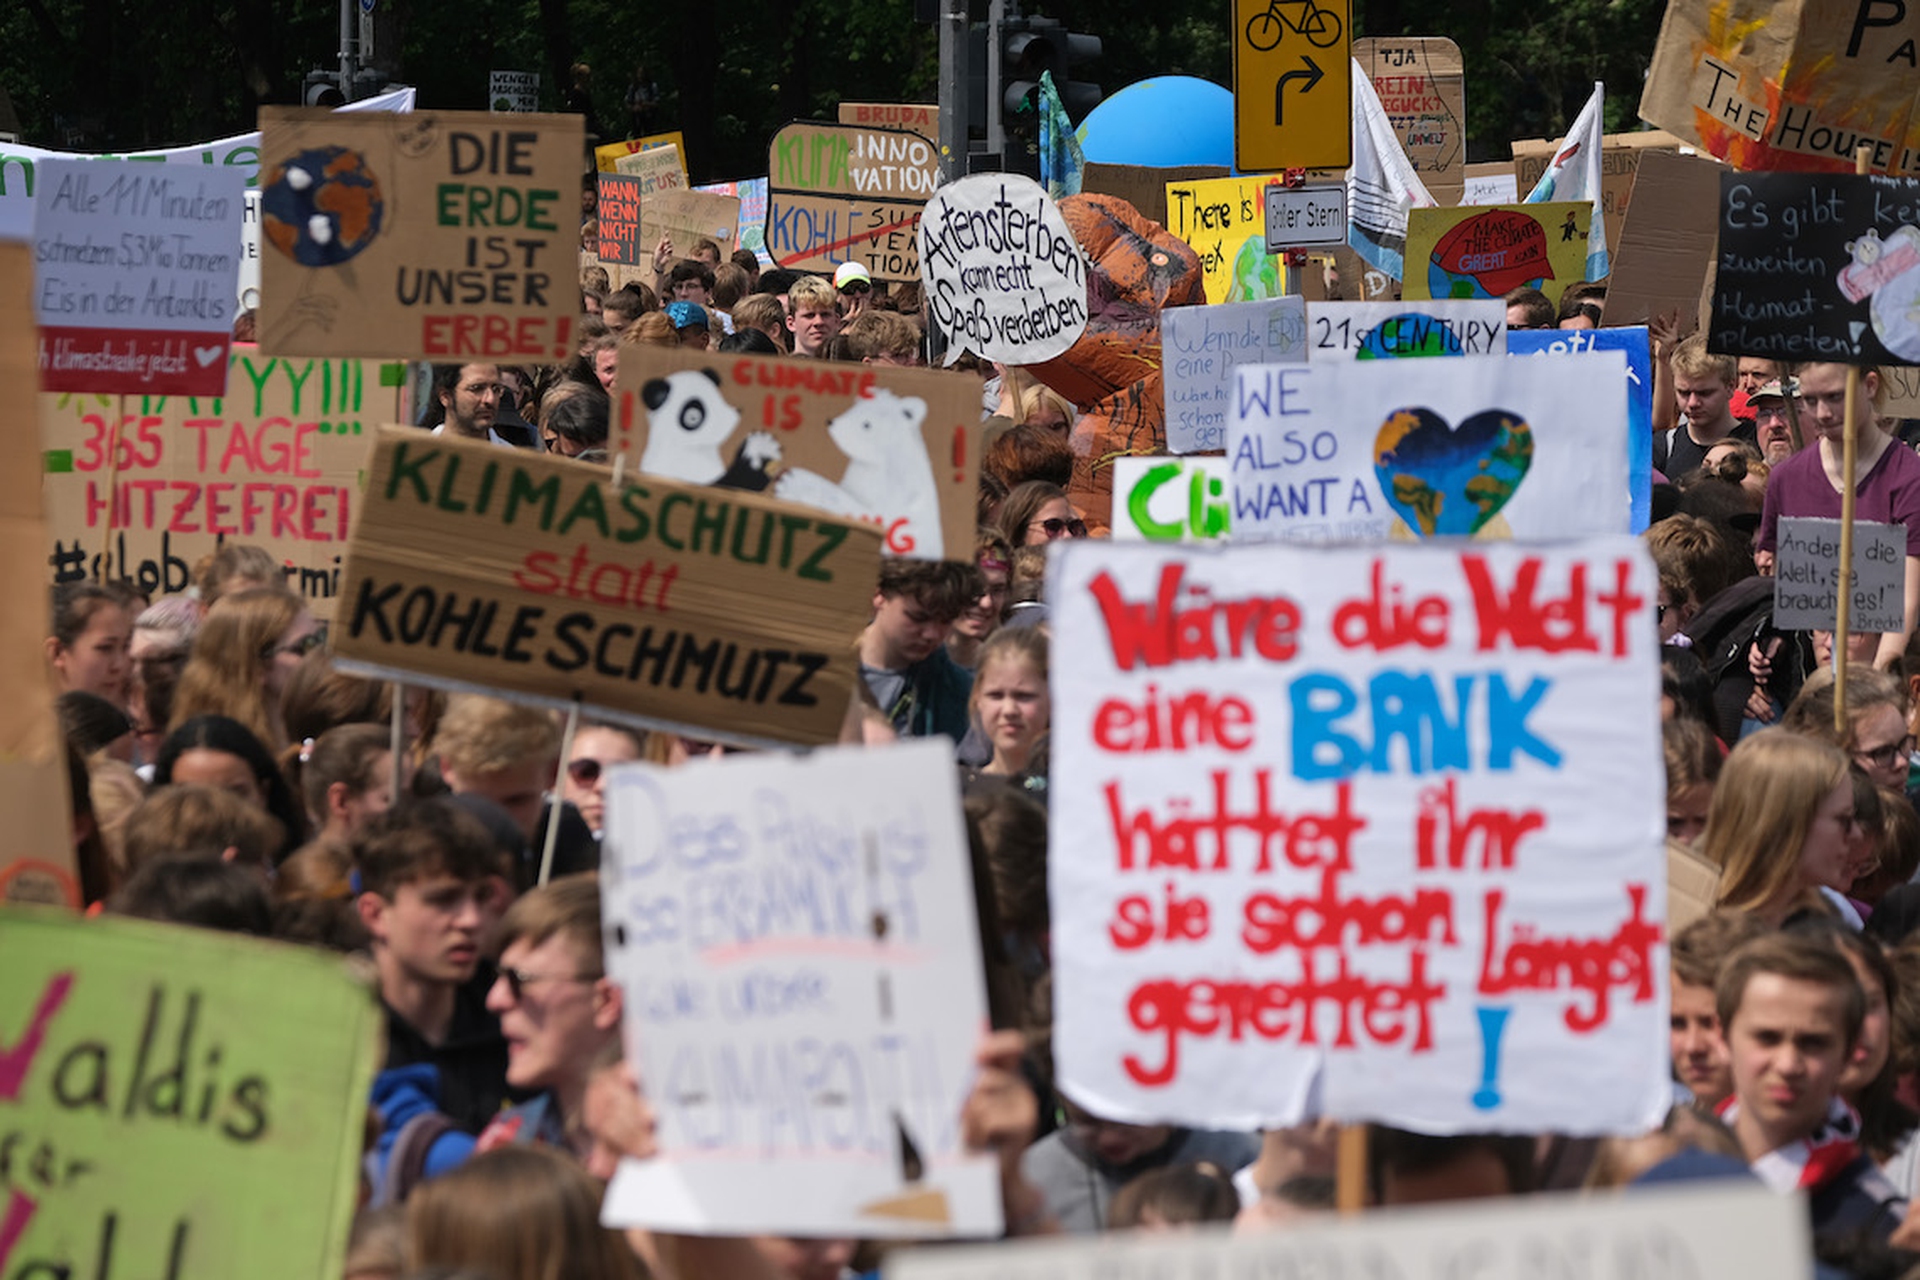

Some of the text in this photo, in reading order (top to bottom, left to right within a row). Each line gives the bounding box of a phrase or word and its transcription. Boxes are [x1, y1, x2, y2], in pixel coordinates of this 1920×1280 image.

[1379, 48, 1416, 66] TJA
[857, 105, 930, 126] BRUDA
[1381, 96, 1441, 113] EGUCKT
[1704, 59, 1766, 136] THE
[450, 129, 539, 177] DIE
[776, 131, 850, 189] KLIMA
[856, 133, 930, 167] INNO
[50, 172, 100, 216] Alle
[142, 174, 230, 222] Minuten
[599, 179, 641, 207] WANN,
[849, 164, 940, 195] VATION
[437, 182, 561, 233] ERDE
[599, 201, 639, 222] WENN
[1170, 188, 1232, 237] There
[1306, 200, 1340, 228] Stern
[1473, 216, 1519, 238] MAKE
[1726, 184, 1770, 229] Es
[1781, 186, 1845, 239] gibt
[466, 235, 549, 270] IST
[598, 240, 623, 261] WIR
[599, 221, 639, 242] NICHT
[772, 201, 864, 267] KOHLE
[923, 183, 1083, 288] Artensterben
[1463, 237, 1492, 254] THE
[995, 253, 1036, 293] echt
[1457, 250, 1508, 272] GREAT
[1721, 247, 1826, 277] zweiten
[41, 276, 76, 314] Eis
[102, 280, 136, 315] der
[141, 275, 227, 321] Antarktis
[396, 265, 552, 307] UNSER
[421, 312, 574, 360] ERBE!
[931, 277, 1087, 355] Spaß verderben
[1379, 316, 1503, 354] CENTURY
[730, 359, 879, 400] CLIMATE
[1174, 356, 1214, 379] eine
[762, 393, 804, 432] IS
[1238, 368, 1312, 421] WE
[74, 413, 324, 478] 365 TAGE
[1232, 430, 1338, 473] ALSO
[86, 479, 350, 542] HITZEFREI
[384, 439, 852, 583] KLIMASCHUTZ
[1234, 477, 1373, 522] WANT A
[1865, 538, 1897, 564] die
[511, 543, 681, 613] statt
[1778, 560, 1859, 588] Welt, se
[1087, 552, 1644, 673] Wäre die Welt
[1778, 587, 1839, 611] brauch
[1092, 670, 1566, 783] eine BANK
[1103, 766, 1547, 875] hättet ihr
[1108, 880, 1211, 952] sie
[1241, 868, 1460, 955] schon
[1121, 945, 1447, 1088] gerettet
